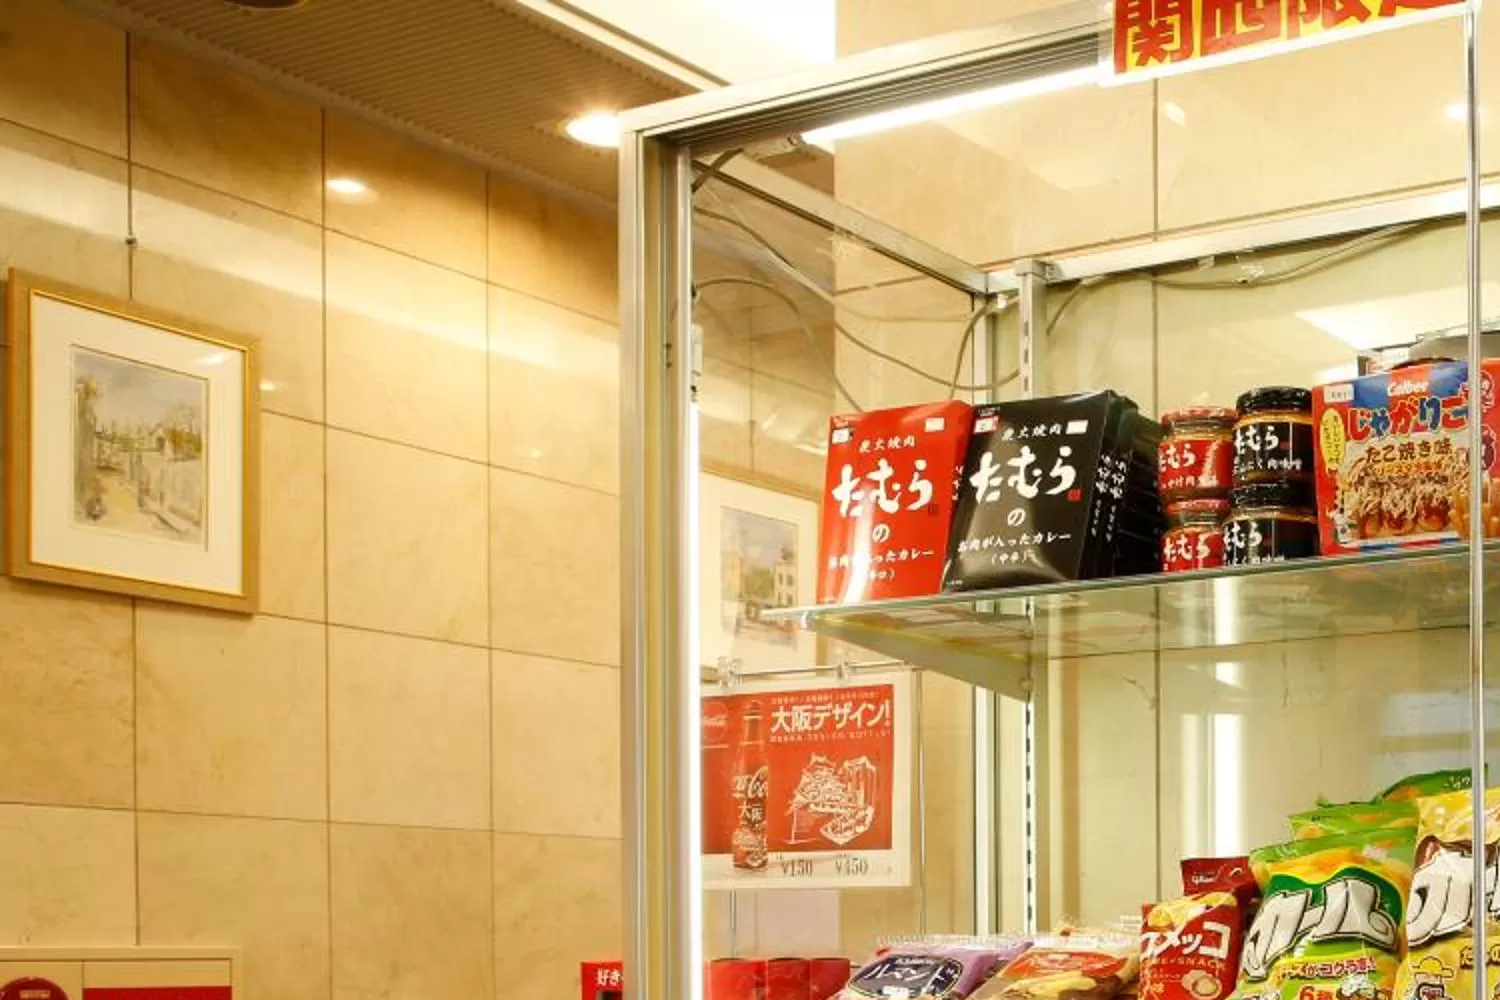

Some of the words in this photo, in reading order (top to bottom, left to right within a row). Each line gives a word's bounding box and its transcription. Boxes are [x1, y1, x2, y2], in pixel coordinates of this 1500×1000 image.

[1113, 0, 1447, 74] 関西
[1348, 396, 1471, 441] じゃがりこ
[1365, 437, 1454, 463] たこ焼き味
[832, 457, 934, 518] たむら
[970, 444, 1077, 504] たむら
[872, 523, 891, 543] の
[1008, 508, 1026, 527] の
[828, 549, 935, 569] お肉ったカレー
[770, 699, 892, 734] 大阪デザイン!
[1243, 878, 1399, 982] カール
